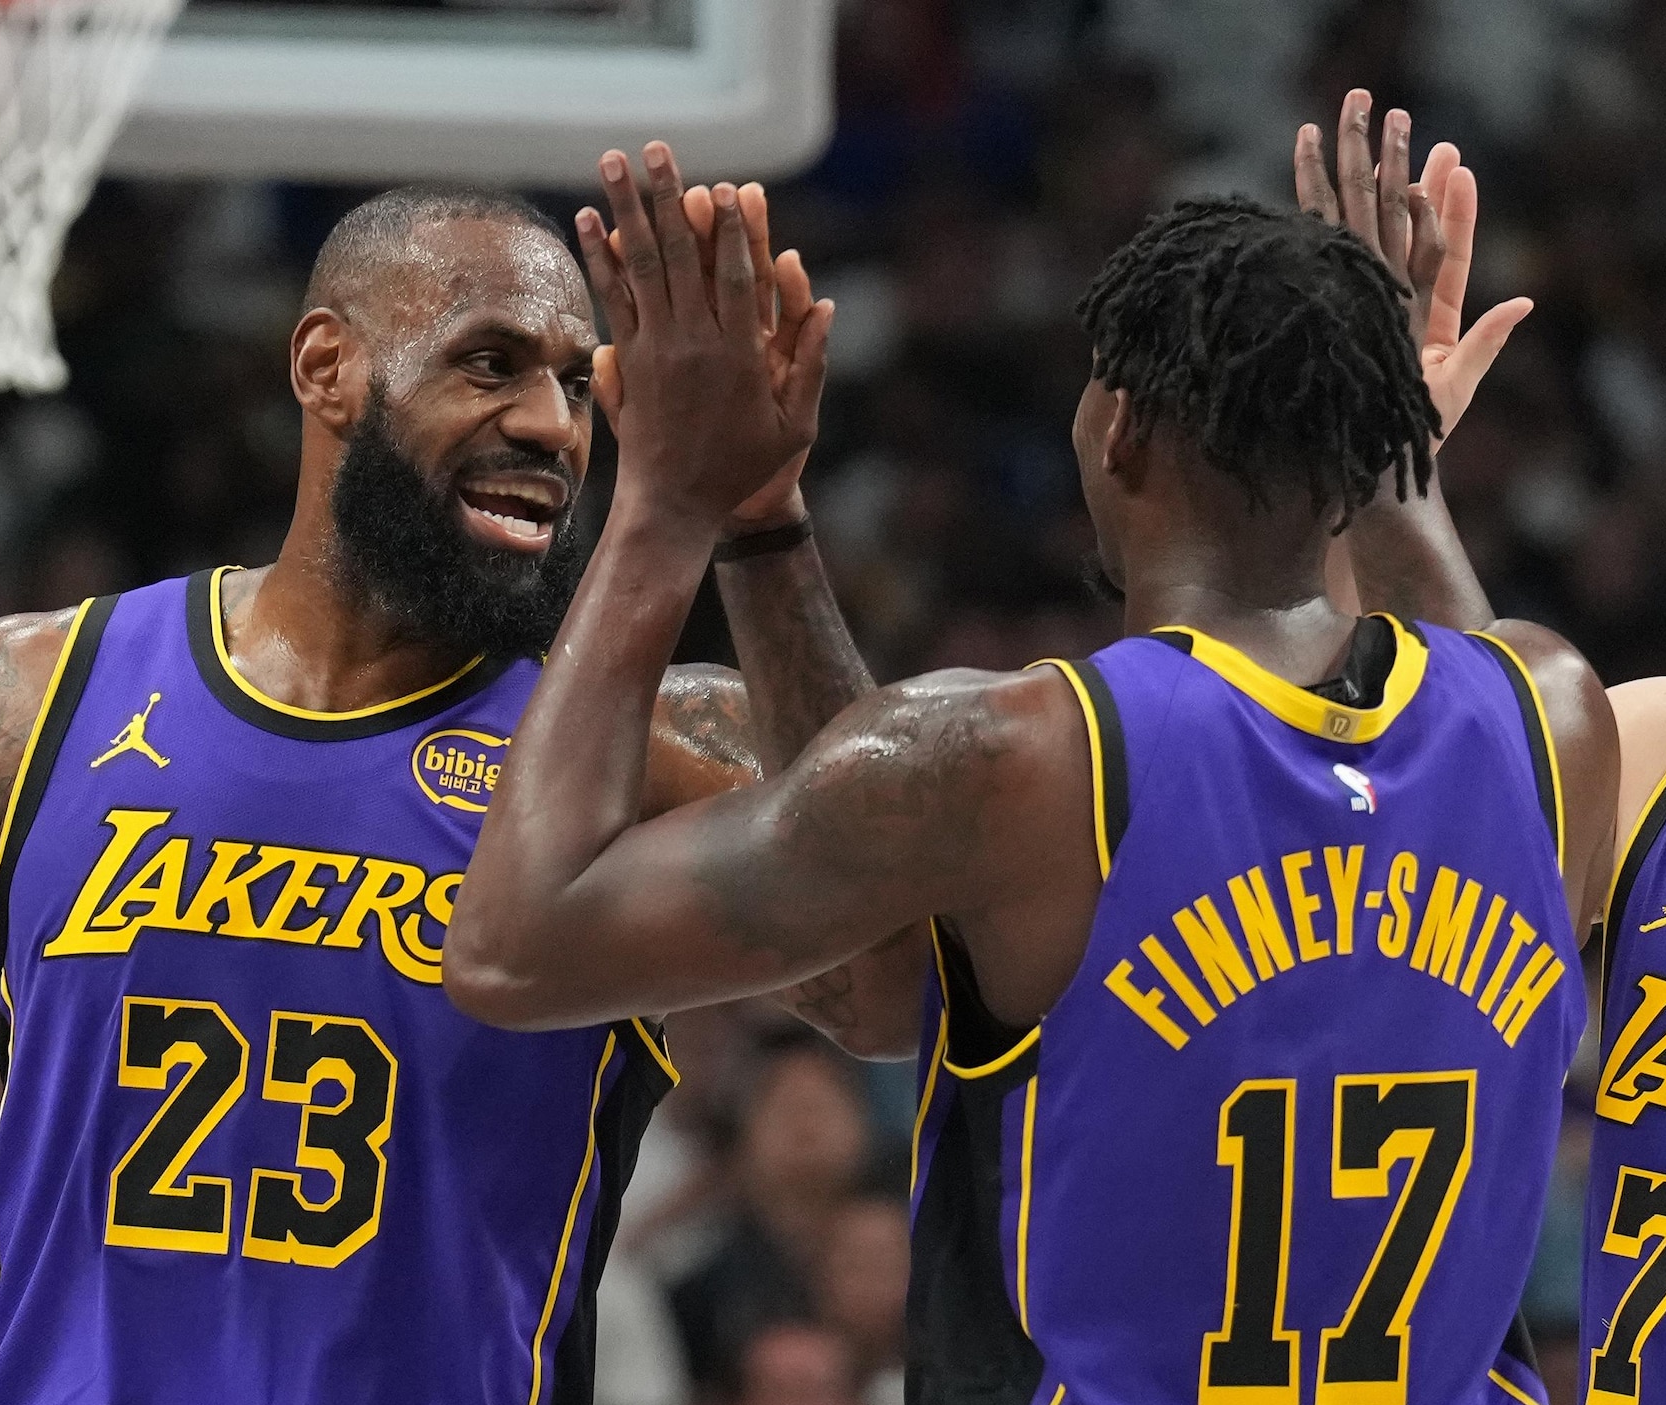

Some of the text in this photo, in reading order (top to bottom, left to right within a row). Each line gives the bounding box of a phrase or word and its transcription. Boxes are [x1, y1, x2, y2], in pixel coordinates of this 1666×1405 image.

[424, 745, 502, 792] bibig
[438, 774, 481, 795] 비비고
[42, 807, 465, 985] LAKERS
[1102, 843, 1566, 1052] FINNEY-SMITH
[103, 996, 399, 1269] 23
